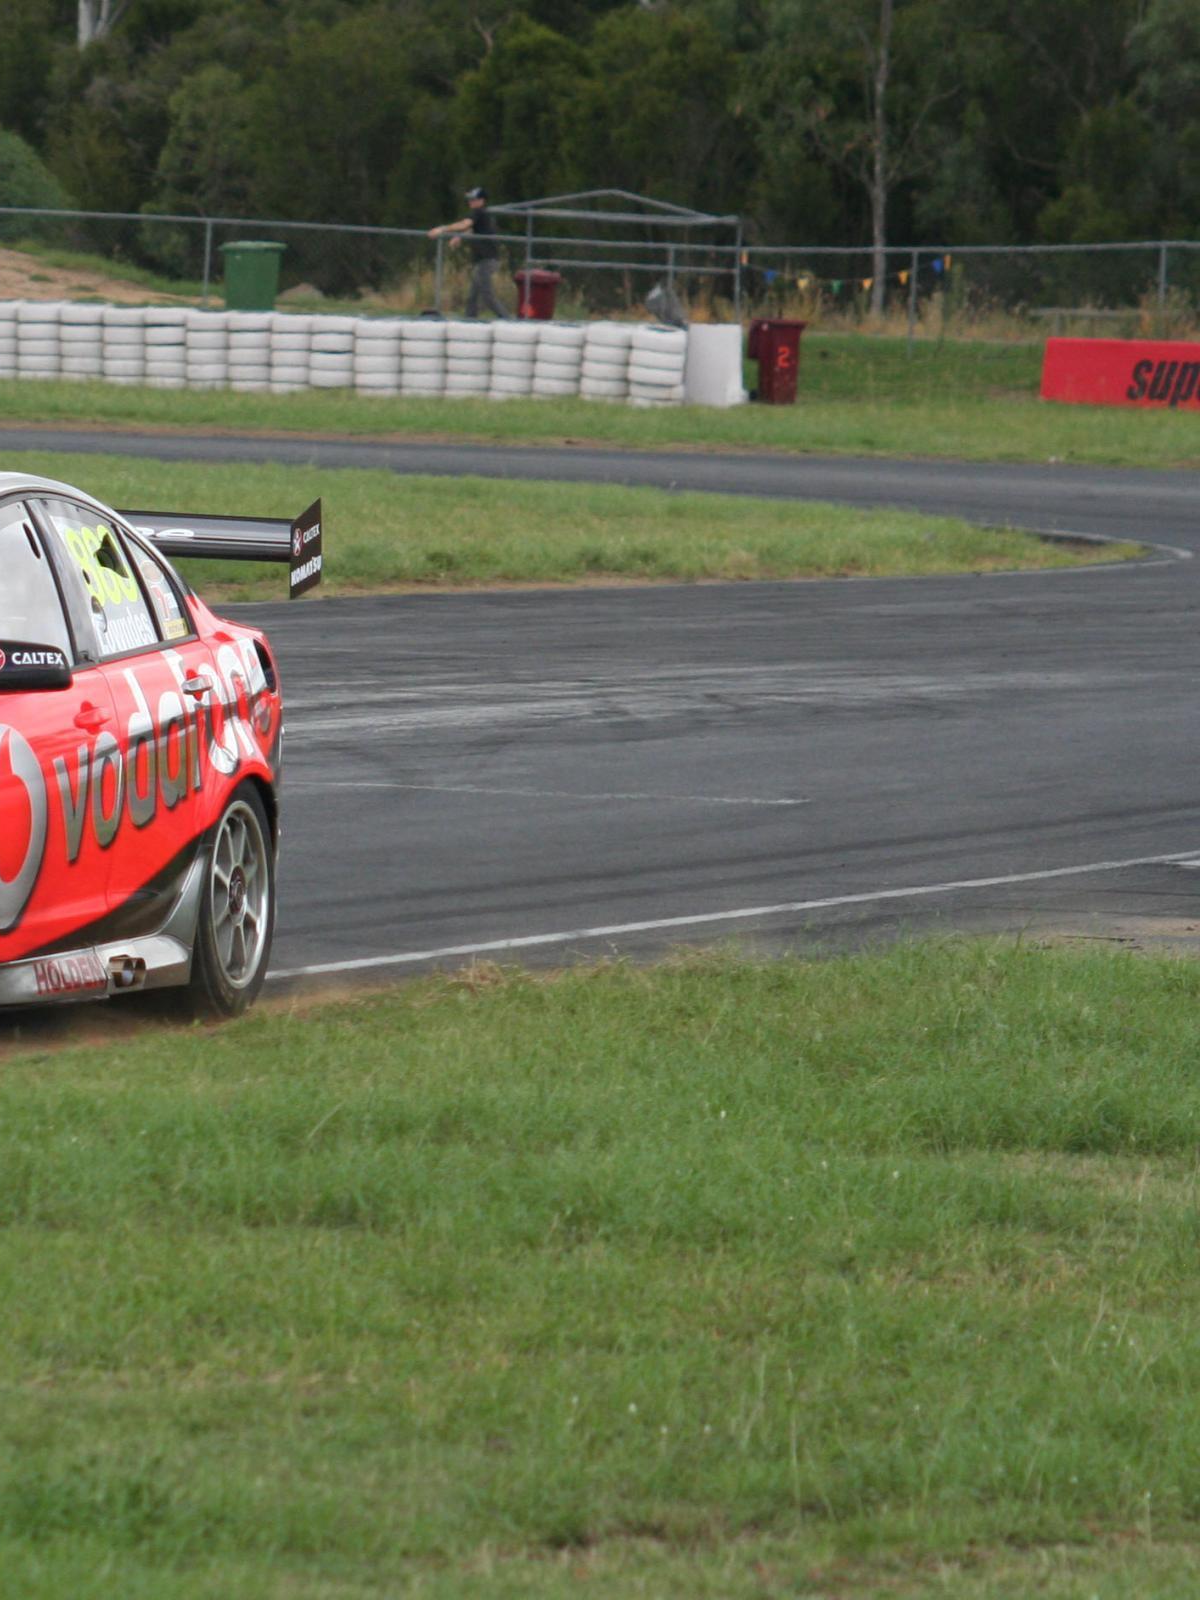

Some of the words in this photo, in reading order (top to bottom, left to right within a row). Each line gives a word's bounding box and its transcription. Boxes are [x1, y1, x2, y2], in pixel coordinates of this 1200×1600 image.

[777, 345, 790, 368] 2
[1126, 359, 1199, 408] sup
[11, 651, 65, 667] CALTEX
[32, 954, 109, 996] HOLDEN
